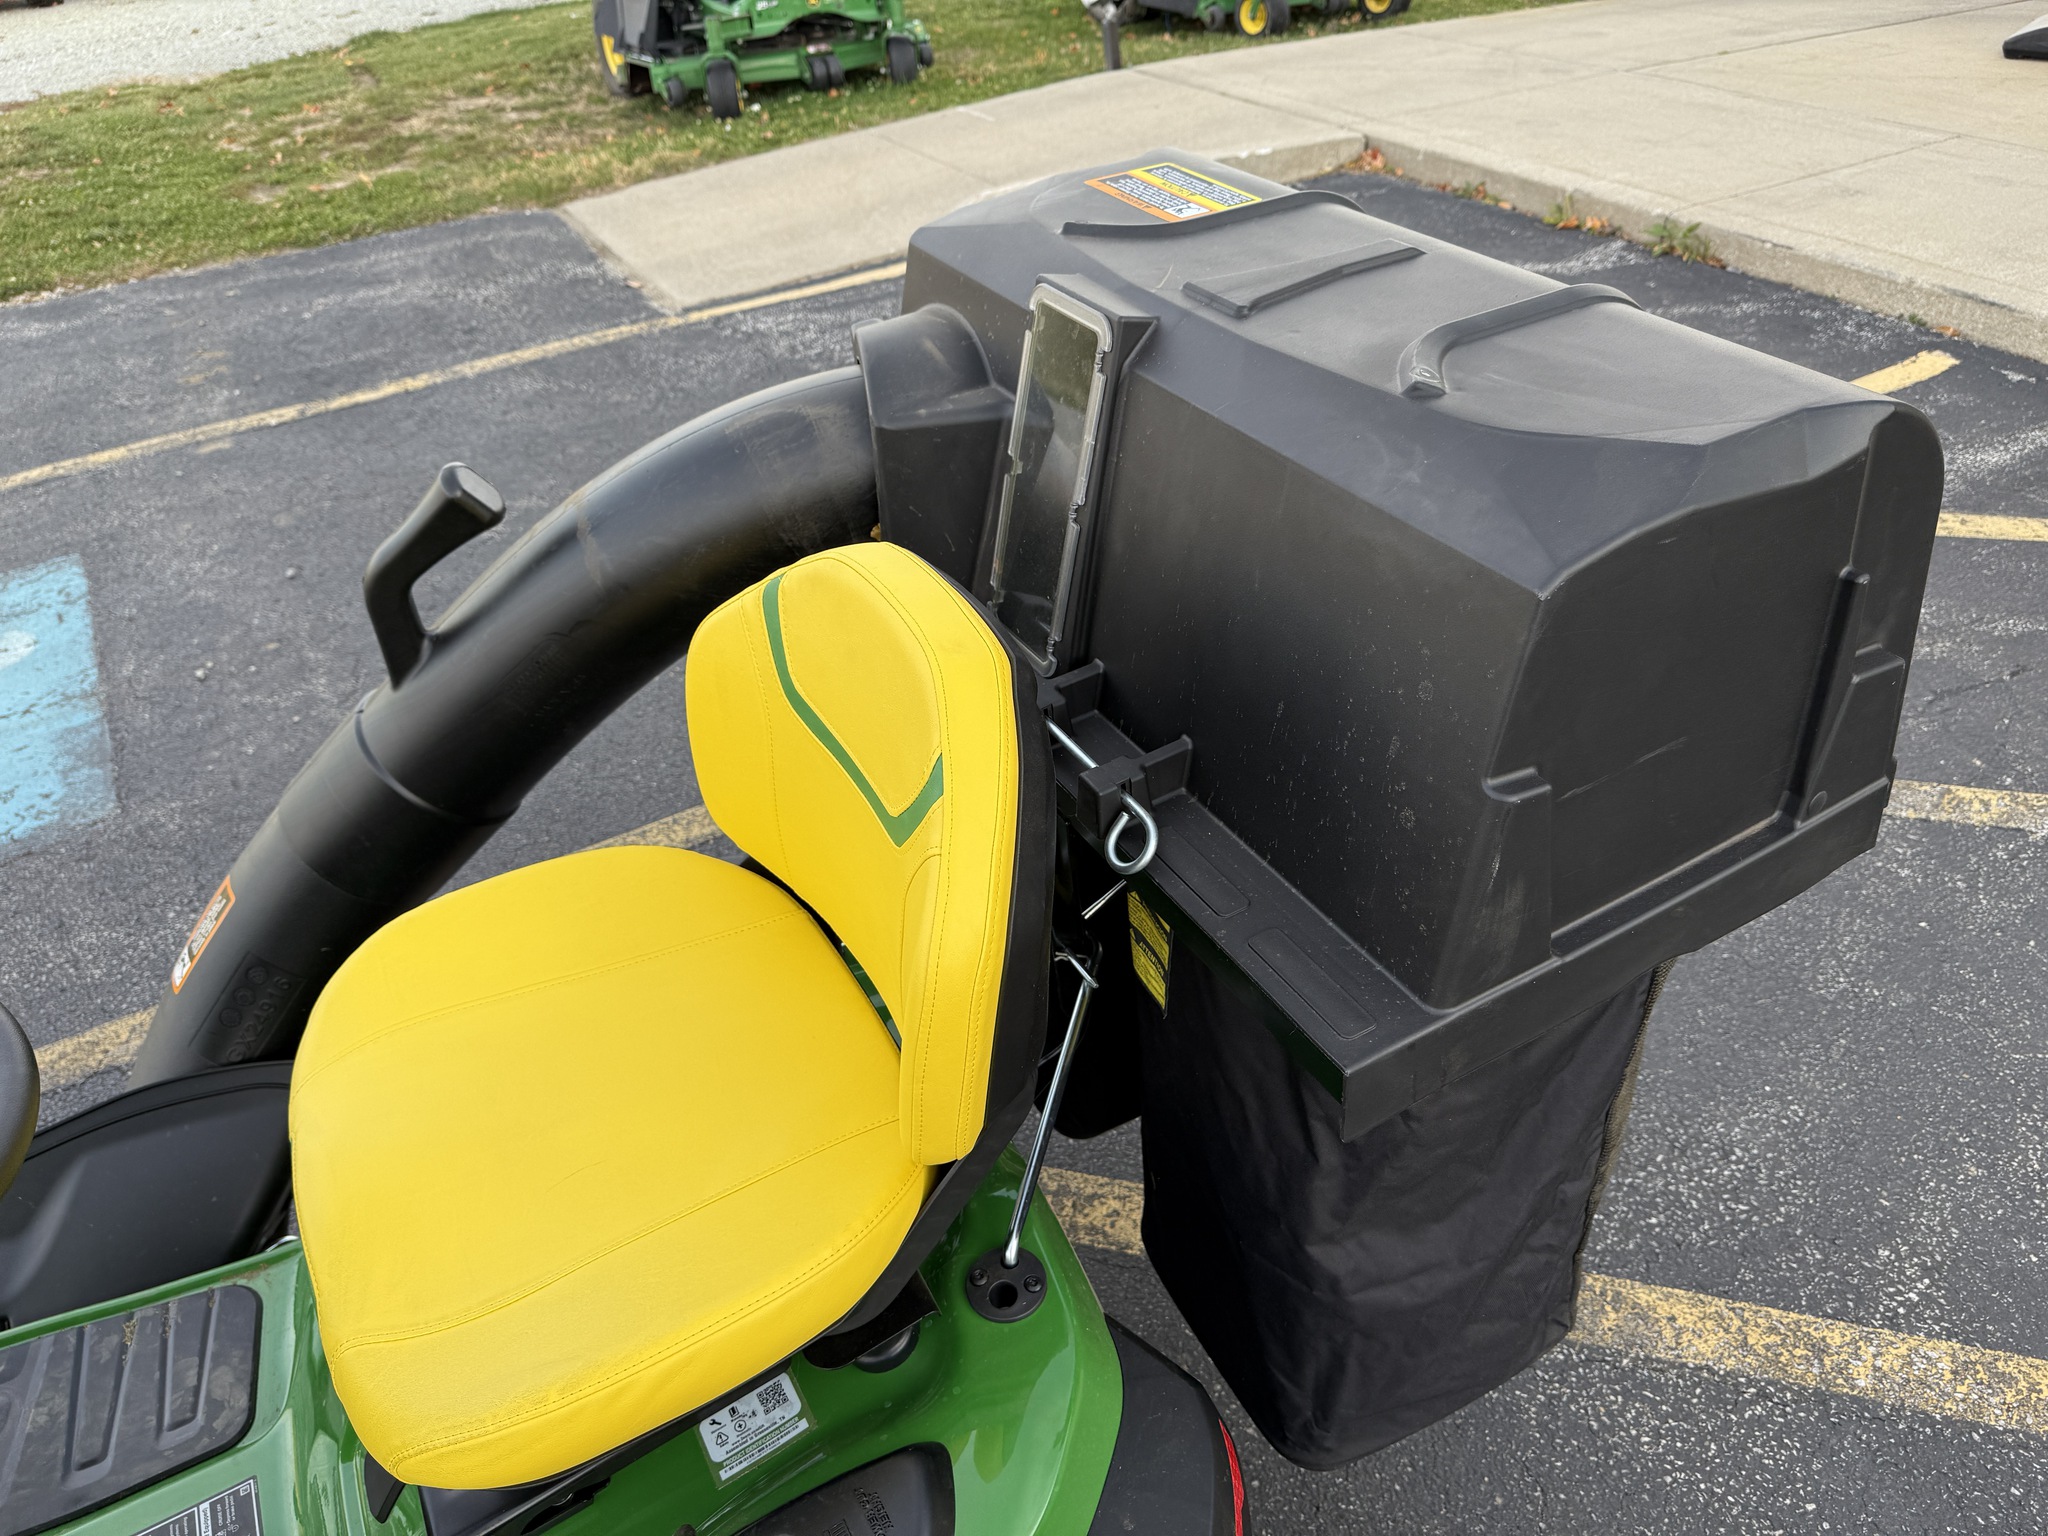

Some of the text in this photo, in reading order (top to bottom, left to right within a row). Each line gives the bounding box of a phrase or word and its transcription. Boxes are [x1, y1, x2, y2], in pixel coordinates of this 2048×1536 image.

[1140, 942, 1164, 976] ATTENTION
[226, 975, 290, 1061] GX24916
[723, 1450, 746, 1467] PRODUCT
[744, 1429, 781, 1454] IDENTIFICATION
[779, 1416, 800, 1433] NUMBER
[868, 1492, 894, 1529] HEIGHT
